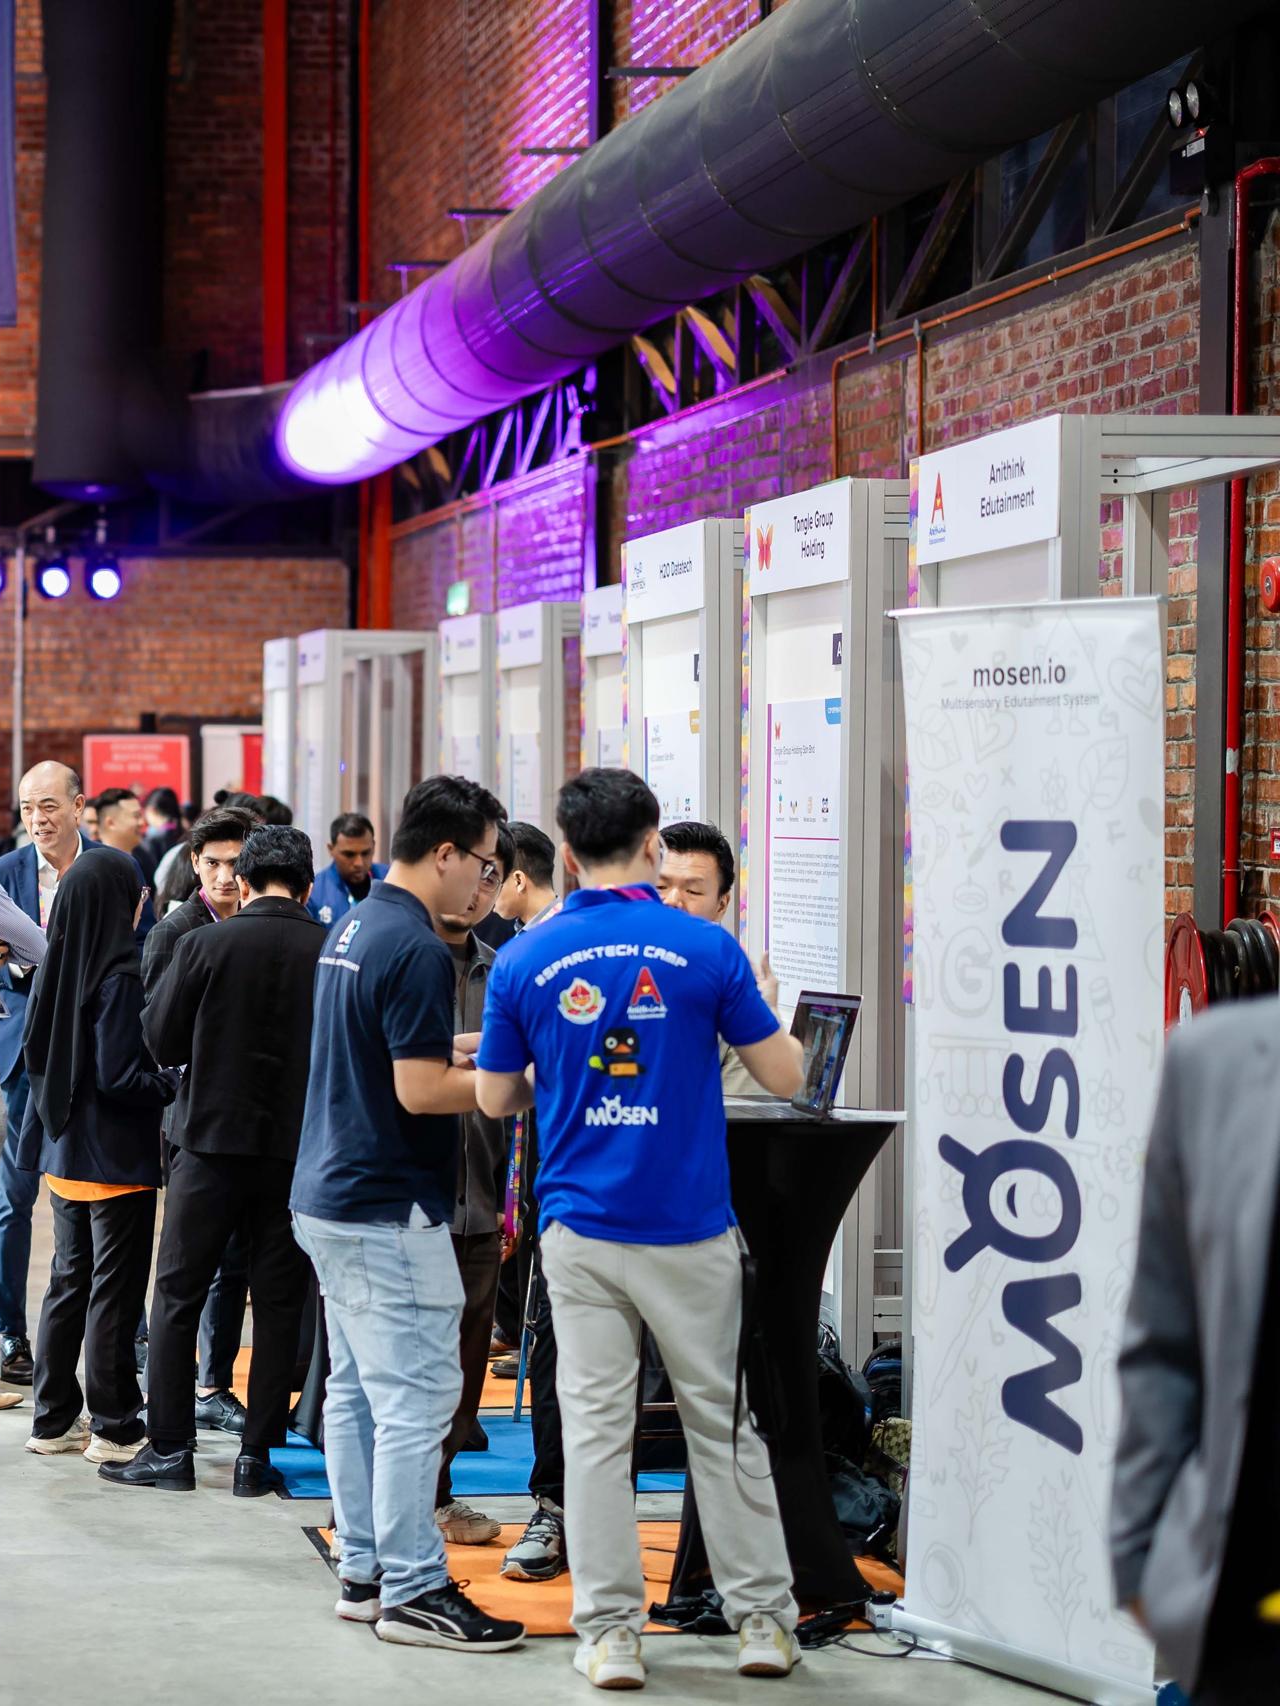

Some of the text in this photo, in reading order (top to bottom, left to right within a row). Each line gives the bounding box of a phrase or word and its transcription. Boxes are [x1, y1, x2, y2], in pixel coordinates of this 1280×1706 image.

[989, 455, 1025, 485] Anithink
[980, 486, 1035, 518] Edutainment
[793, 510, 834, 535] Tongle Group
[801, 538, 825, 559] Holding
[671, 557, 693, 578] Datatech
[973, 658, 1067, 687] mosen.io
[941, 692, 1100, 711] Multisensory Edutainment System
[585, 1095, 658, 1126] MOSEN
[939, 819, 1083, 1455] MOSEN
